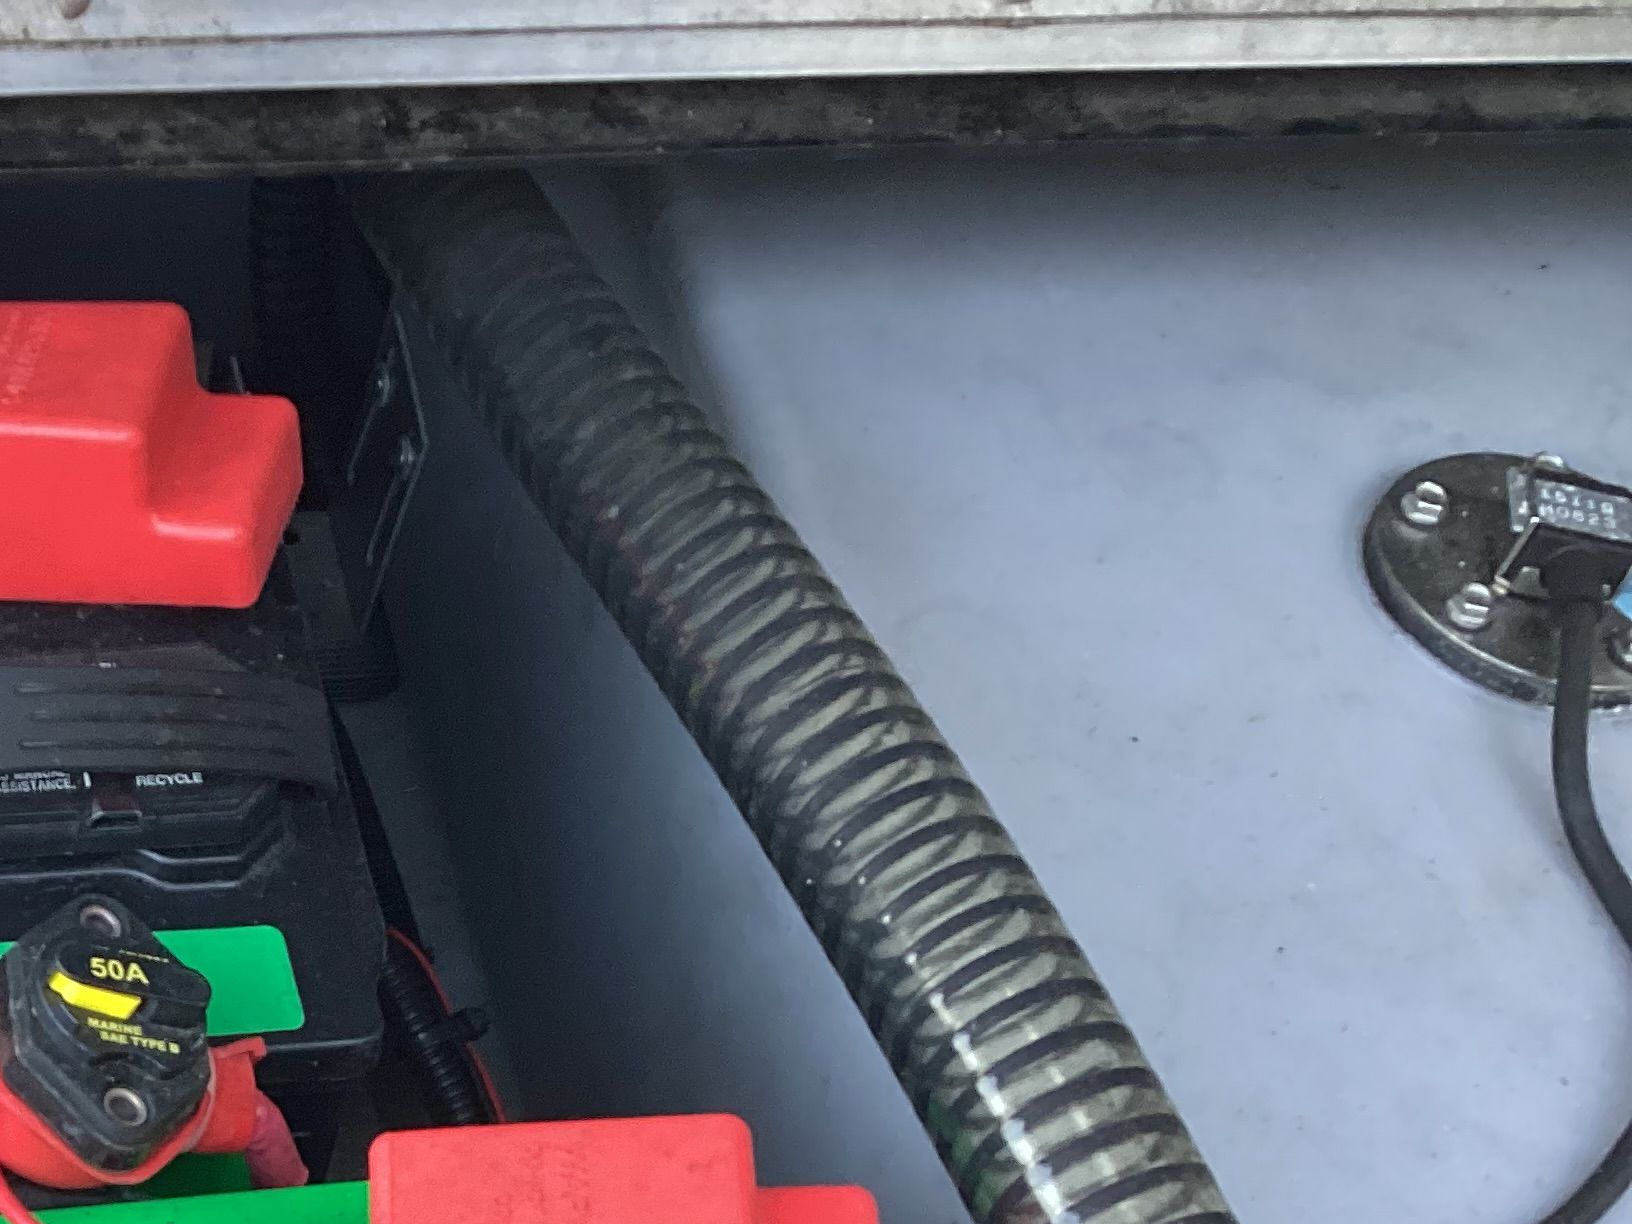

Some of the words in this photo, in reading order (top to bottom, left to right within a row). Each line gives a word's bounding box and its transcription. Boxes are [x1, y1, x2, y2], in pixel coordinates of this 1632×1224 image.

[135, 771, 204, 788] RECYCLE
[89, 956, 150, 987] 50A
[86, 1016, 144, 1036] MARINE
[129, 1035, 167, 1053] TYPE
